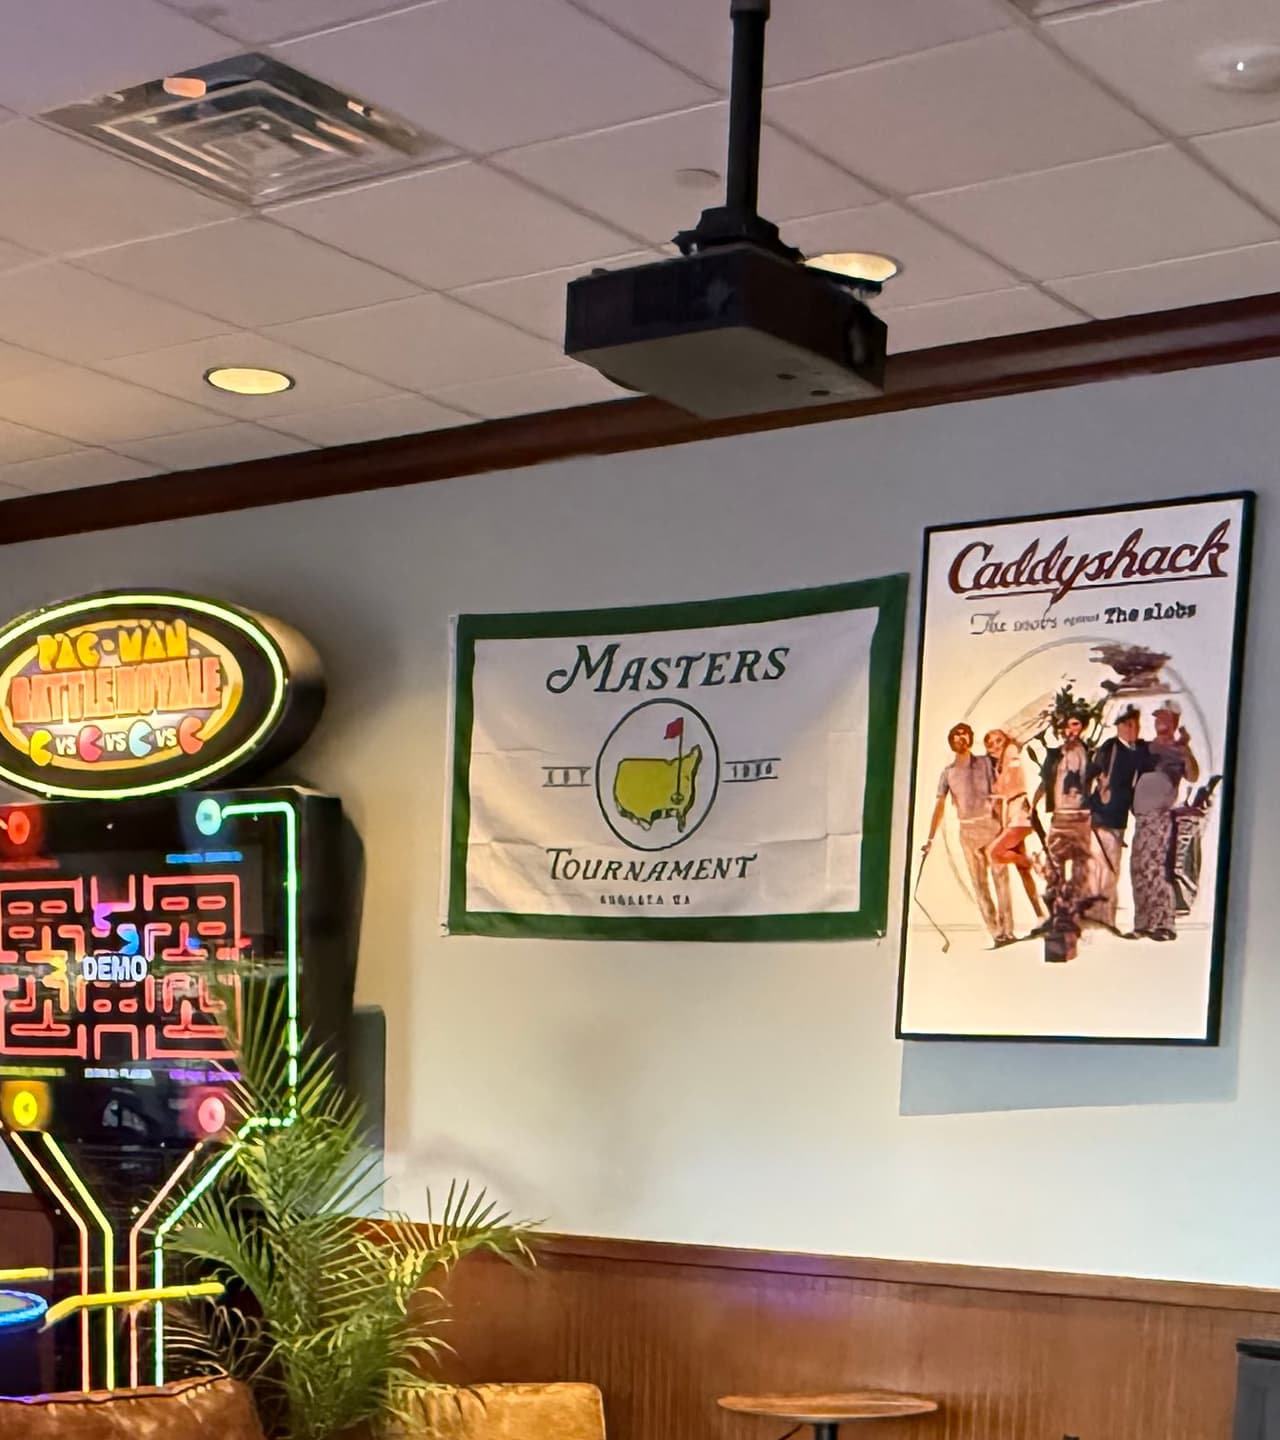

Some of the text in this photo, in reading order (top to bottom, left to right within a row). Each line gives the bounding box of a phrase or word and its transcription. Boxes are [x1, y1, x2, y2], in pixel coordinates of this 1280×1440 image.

[948, 518, 1231, 608] Caddyshack
[1104, 605, 1139, 625] The
[546, 848, 758, 883] TOURNAMENT
[82, 955, 148, 983] DEMO
